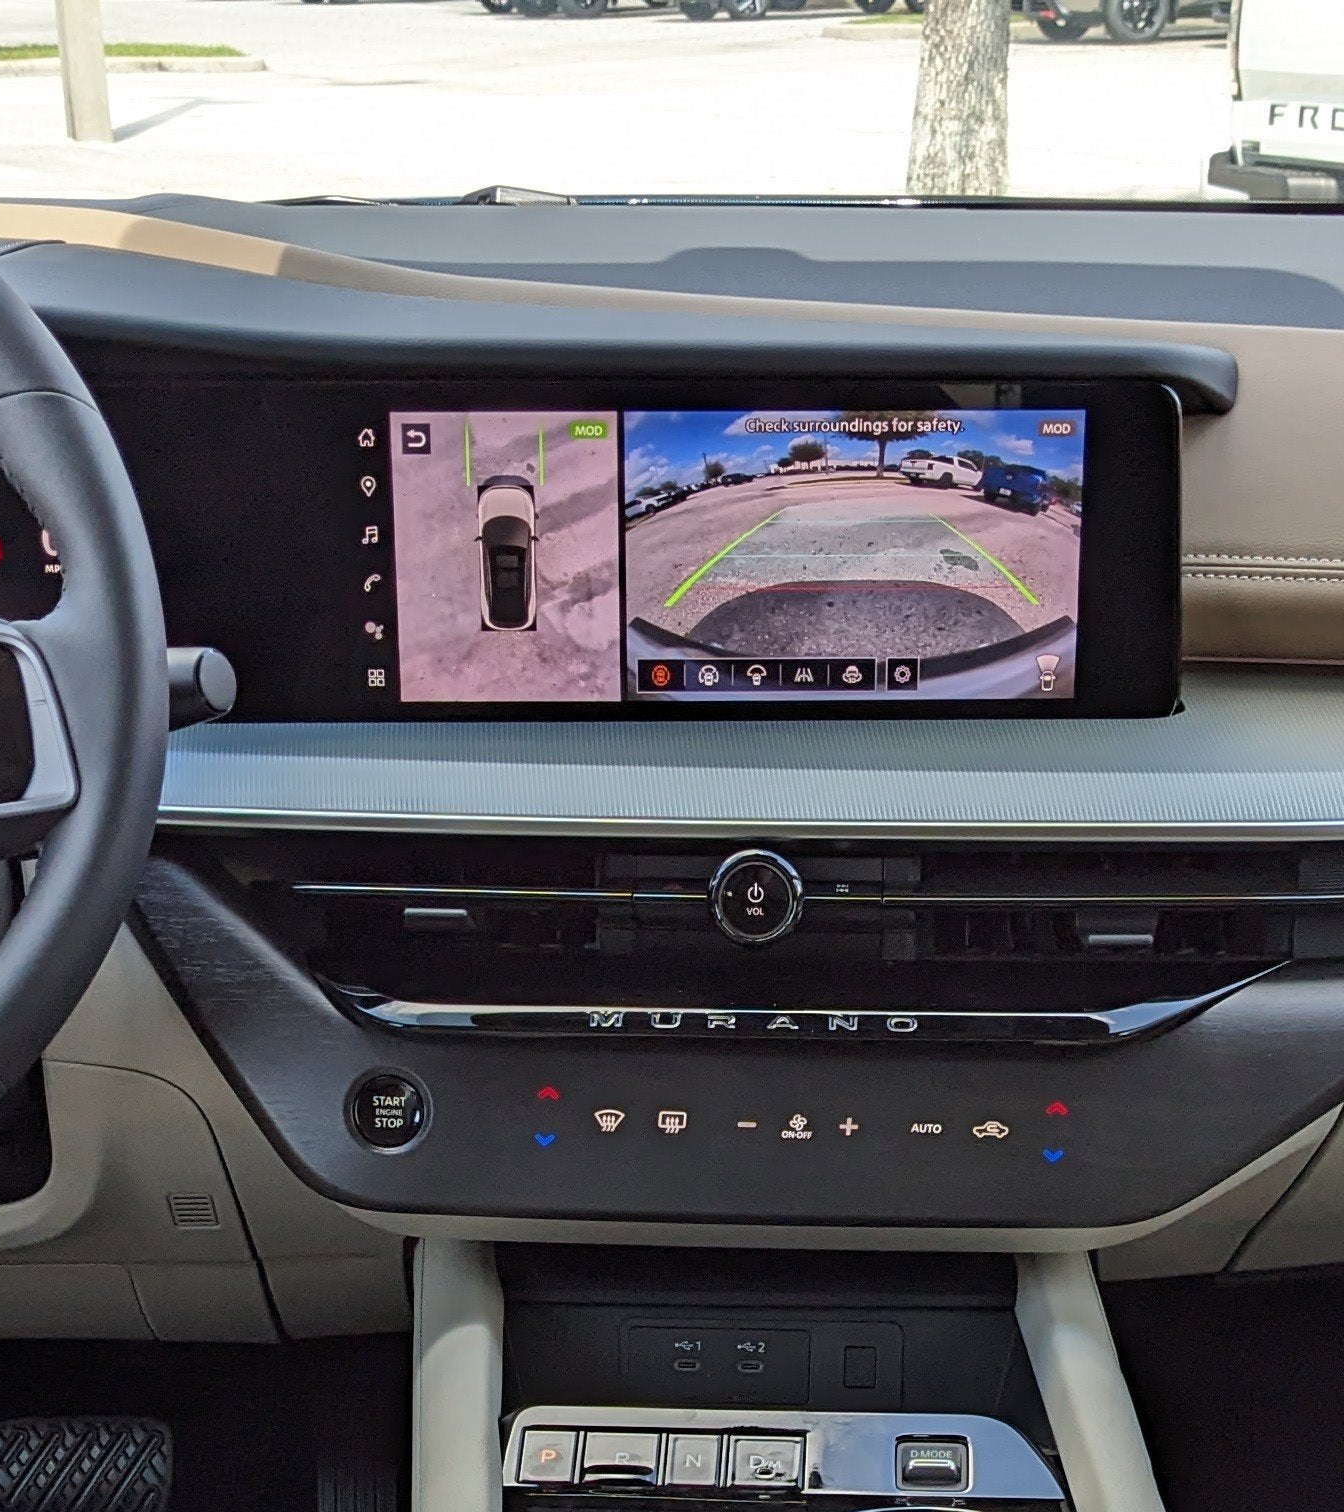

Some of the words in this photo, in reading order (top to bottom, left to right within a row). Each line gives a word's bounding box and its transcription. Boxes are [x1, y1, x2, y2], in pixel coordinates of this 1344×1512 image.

[575, 425, 603, 436] MOD
[746, 419, 789, 433] Check
[792, 419, 889, 436] surroundings
[892, 418, 913, 433] for
[916, 418, 964, 436] safety.
[1043, 423, 1071, 434] MOD
[44, 564, 61, 573] MP
[746, 907, 764, 916] VOL
[588, 1011, 918, 1033] MURANO
[372, 1095, 406, 1106] START
[375, 1108, 403, 1116] ENGINE
[375, 1118, 404, 1128] STOP
[911, 1123, 942, 1134] AUTO
[696, 1341, 701, 1350] 1
[758, 1342, 765, 1353] 2
[541, 1449, 556, 1464] P
[615, 1453, 630, 1465] R
[685, 1454, 701, 1467] N
